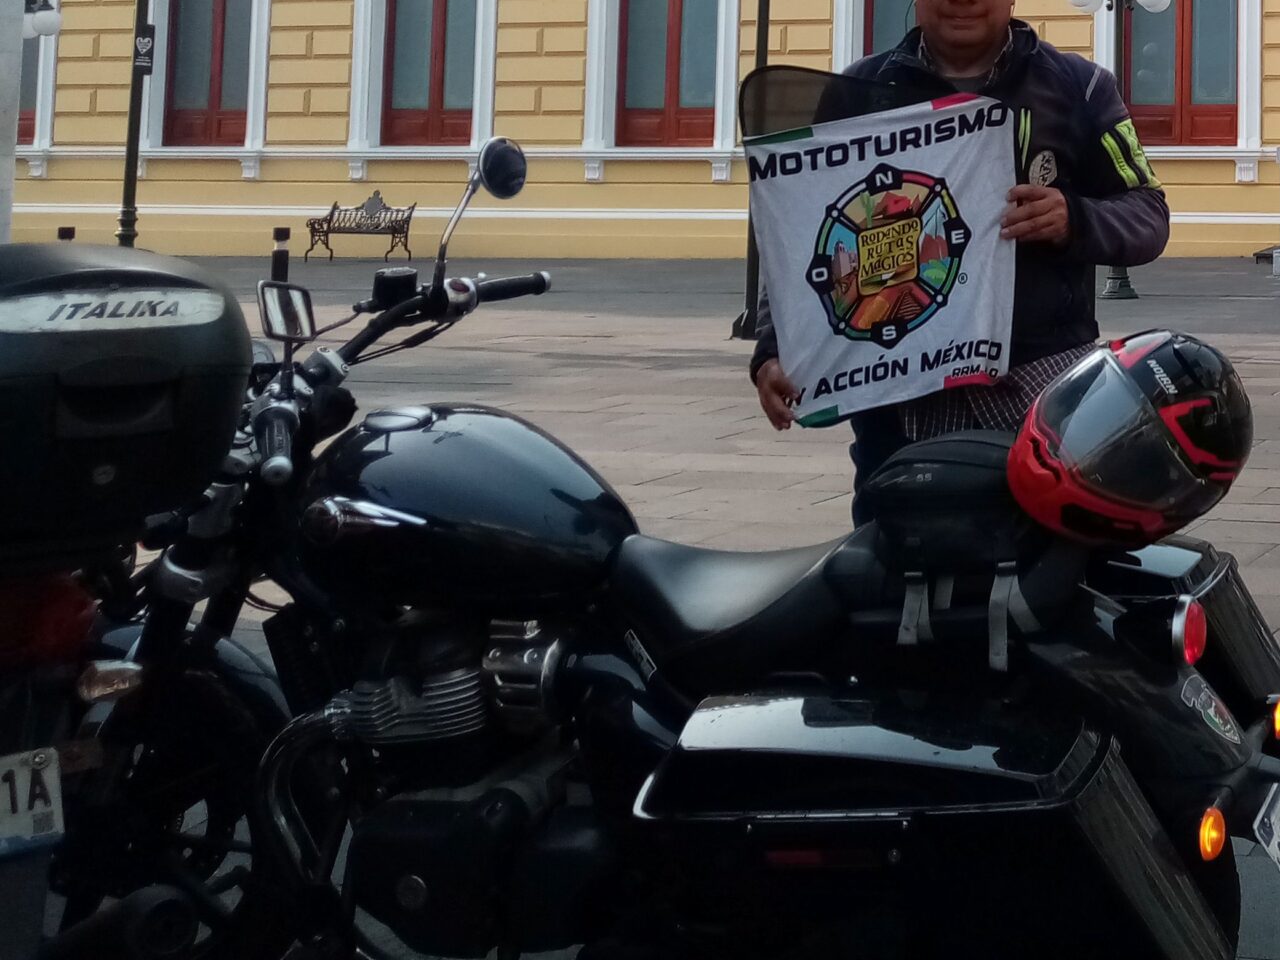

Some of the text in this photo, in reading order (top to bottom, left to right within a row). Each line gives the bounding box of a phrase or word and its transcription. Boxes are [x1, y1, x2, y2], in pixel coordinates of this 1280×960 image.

[750, 102, 1009, 182] MOTOTURISMO
[875, 170, 894, 185] N
[951, 229, 965, 243] E
[812, 267, 828, 282] O
[46, 300, 180, 322] ITALIKA
[882, 325, 896, 340] S
[813, 354, 909, 400] ACCIÓN
[920, 339, 1003, 373] MÉXICO
[1146, 359, 1178, 395] NOLAN
